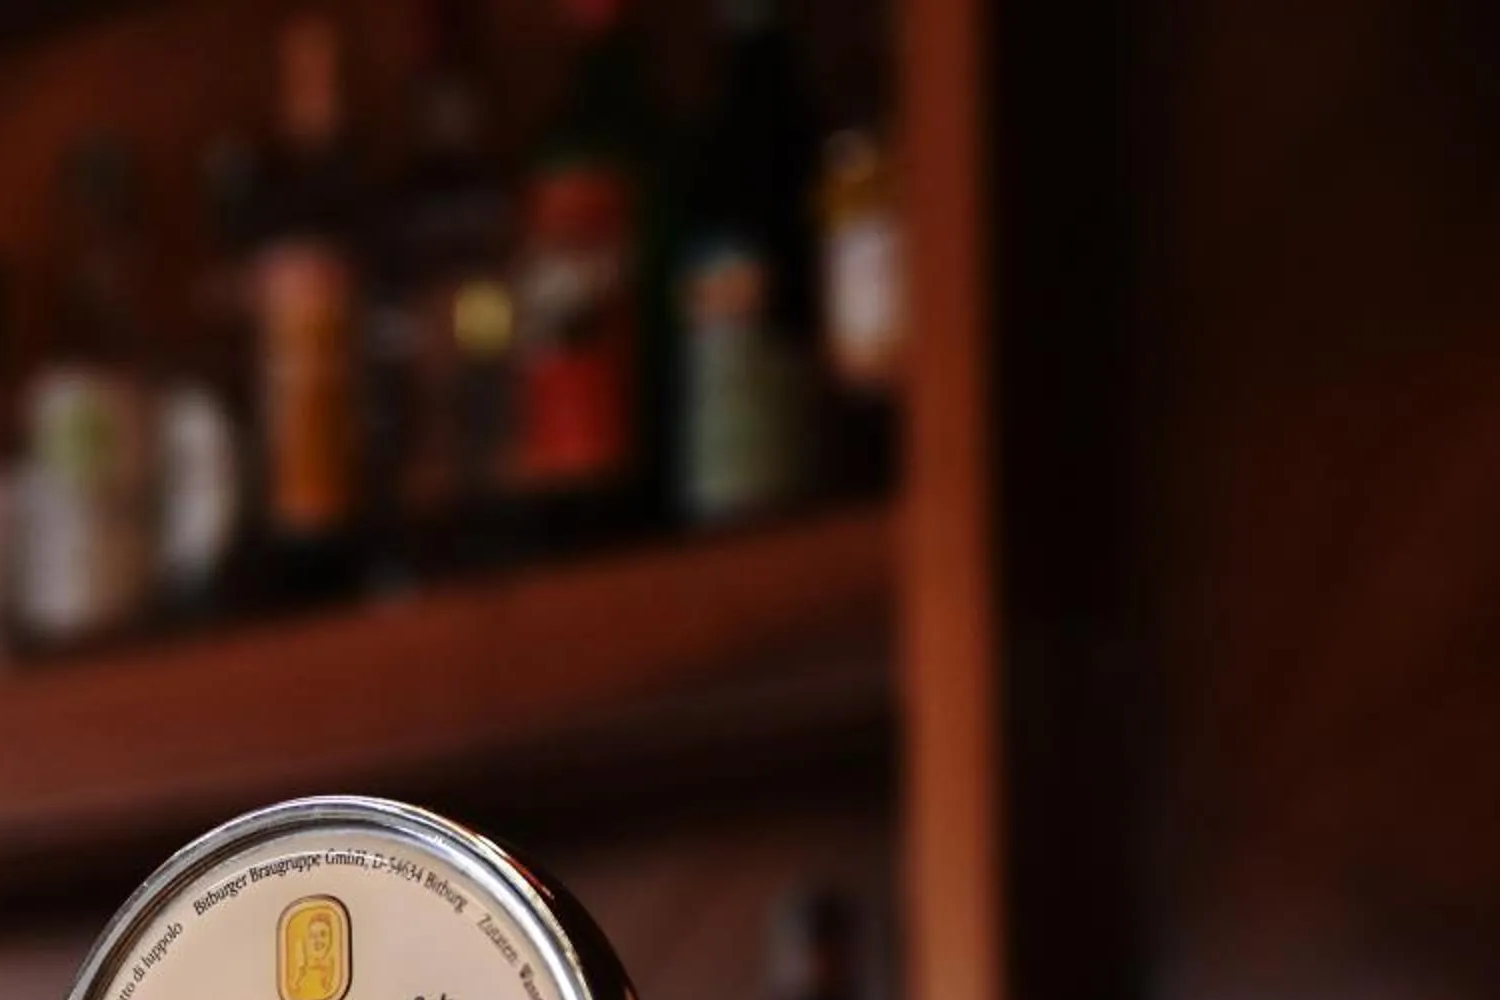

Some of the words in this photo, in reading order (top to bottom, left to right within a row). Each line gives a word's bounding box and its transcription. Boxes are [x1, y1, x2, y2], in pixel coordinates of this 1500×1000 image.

[193, 873, 248, 916] Bitburger
[248, 853, 322, 883] Braugruppe
[423, 871, 468, 914] Bitburg
[132, 964, 146, 983] di
[141, 922, 184, 970] luppolo
